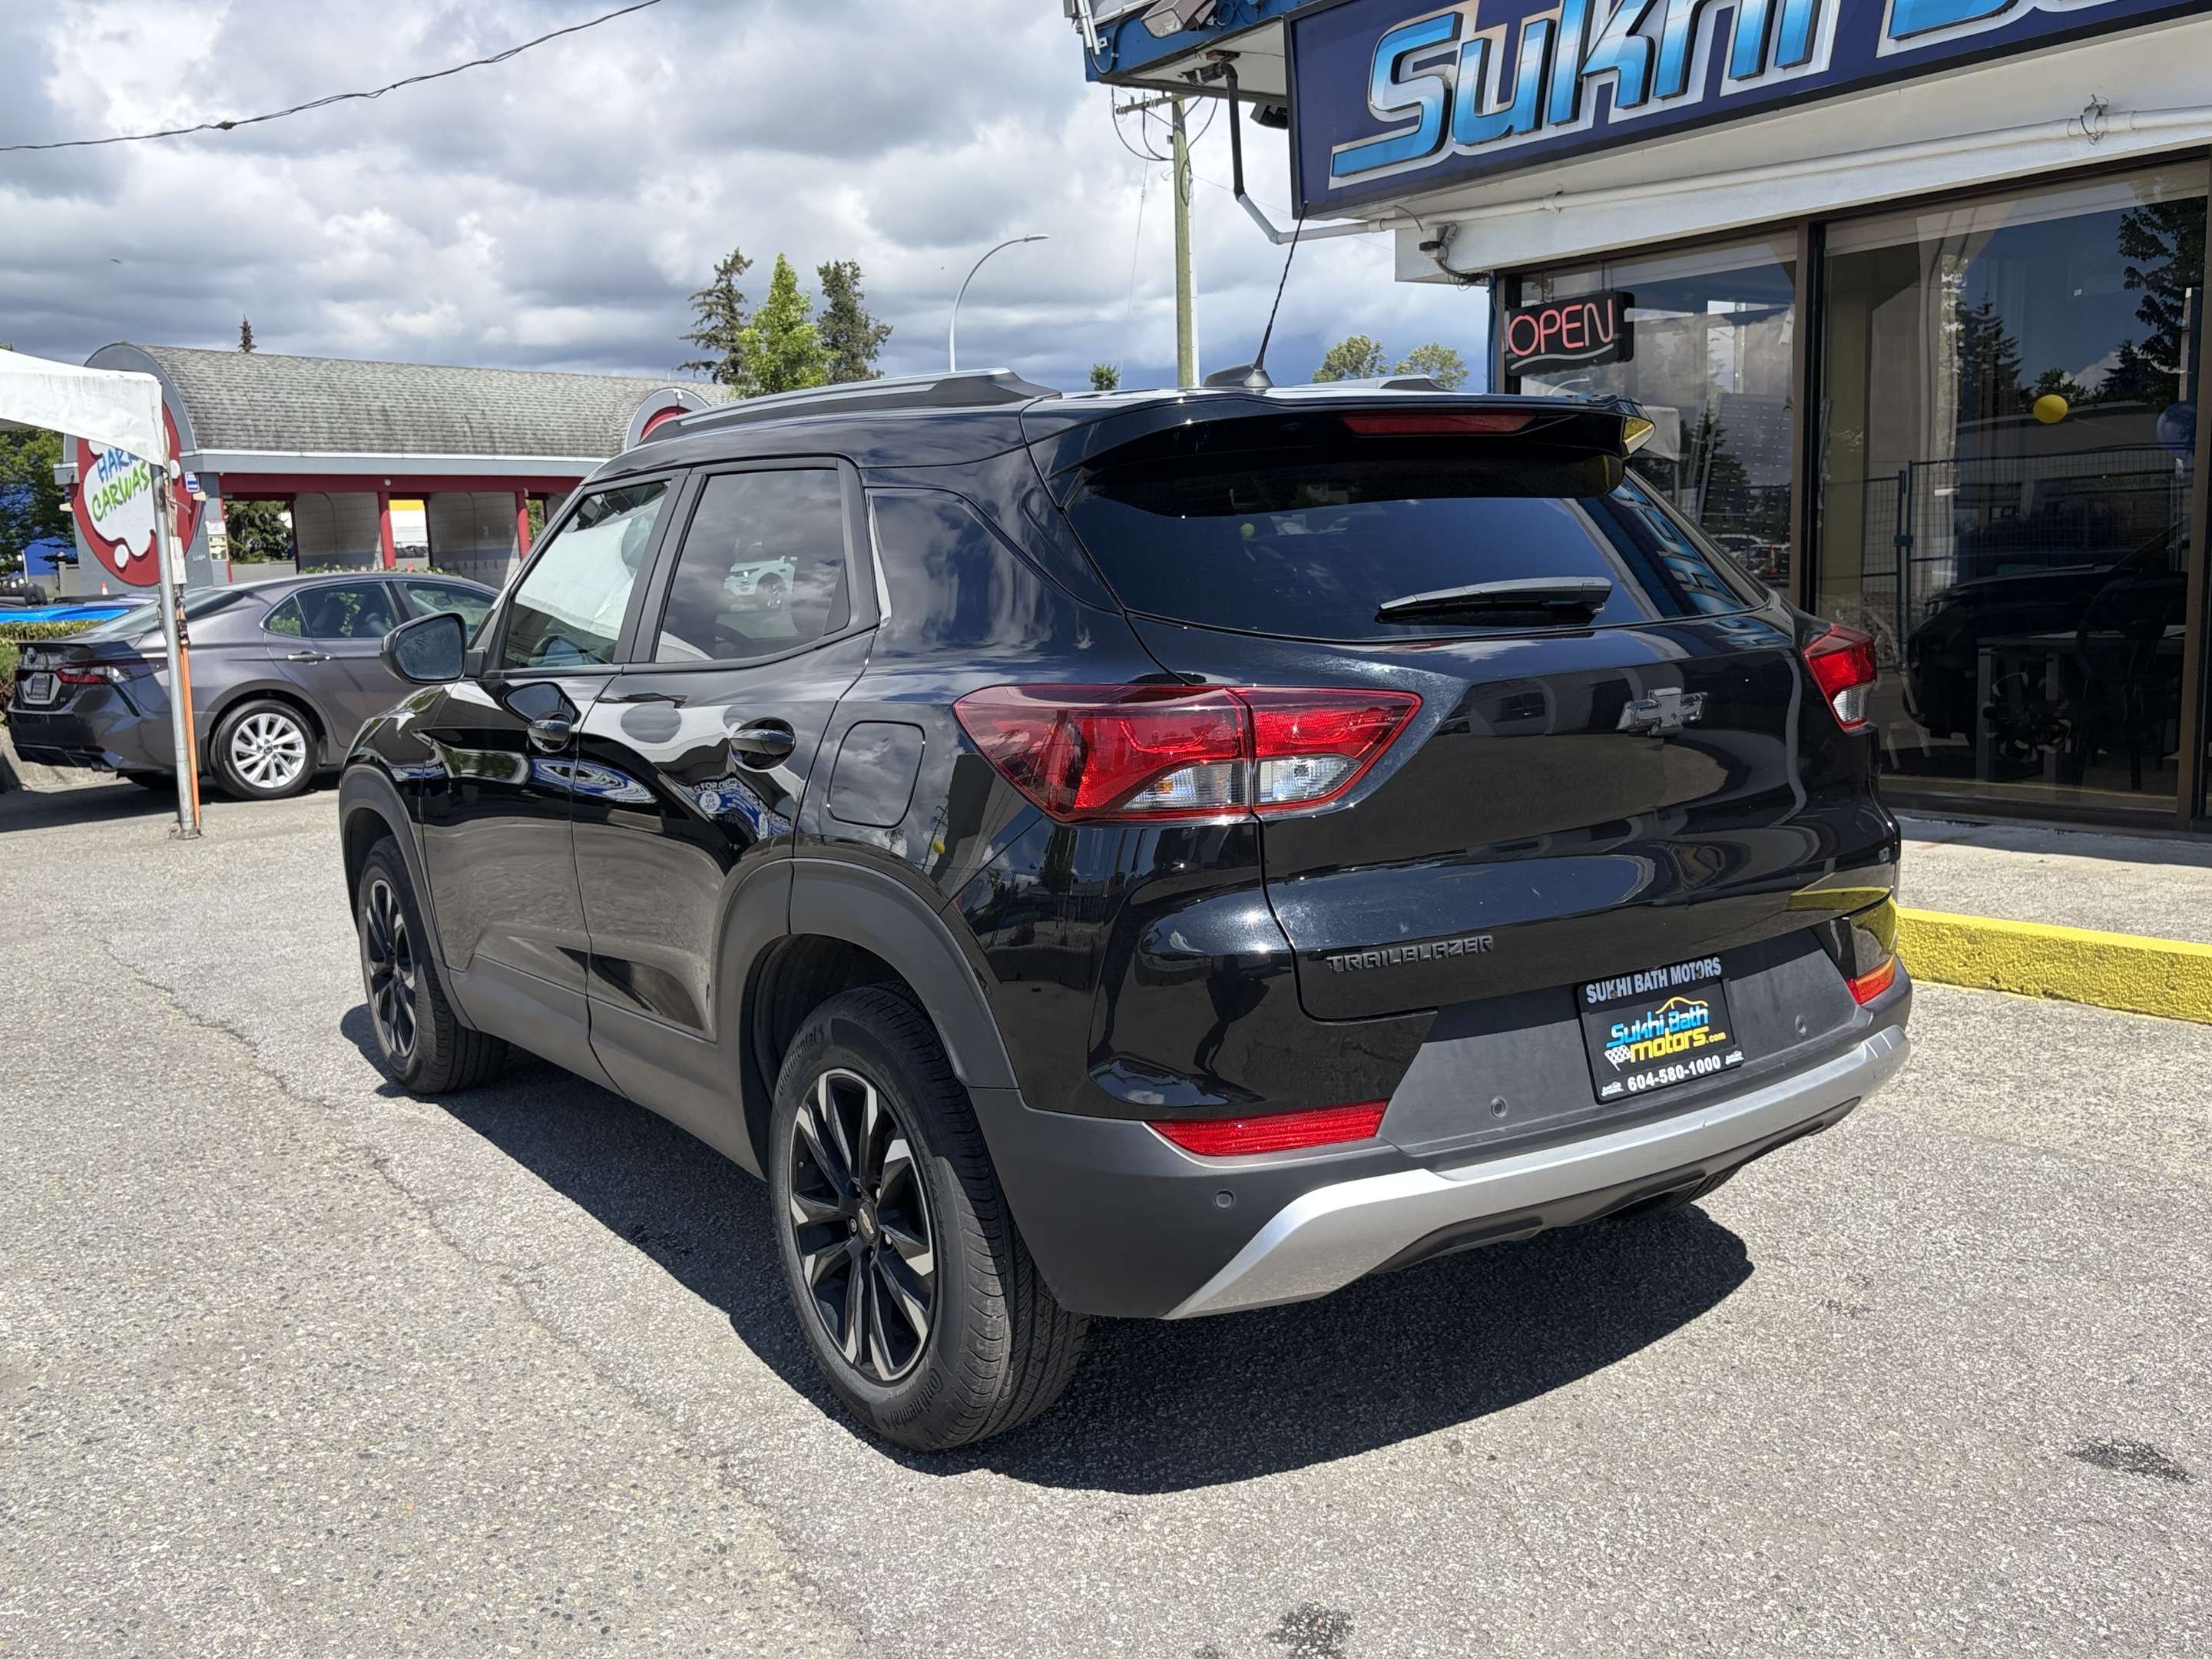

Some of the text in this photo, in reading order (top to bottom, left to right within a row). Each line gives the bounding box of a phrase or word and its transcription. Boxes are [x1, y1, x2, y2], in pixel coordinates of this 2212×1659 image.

[1508, 298, 1614, 356] OPEN
[91, 460, 151, 523] CARWAS
[1324, 934, 1494, 972] TRAILBLAZER
[1585, 956, 1723, 1005] SUKHI BATH MOTORS
[1605, 1005, 1710, 1048] Sukhi Bath
[1627, 1054, 1723, 1093] 604-580-1000
